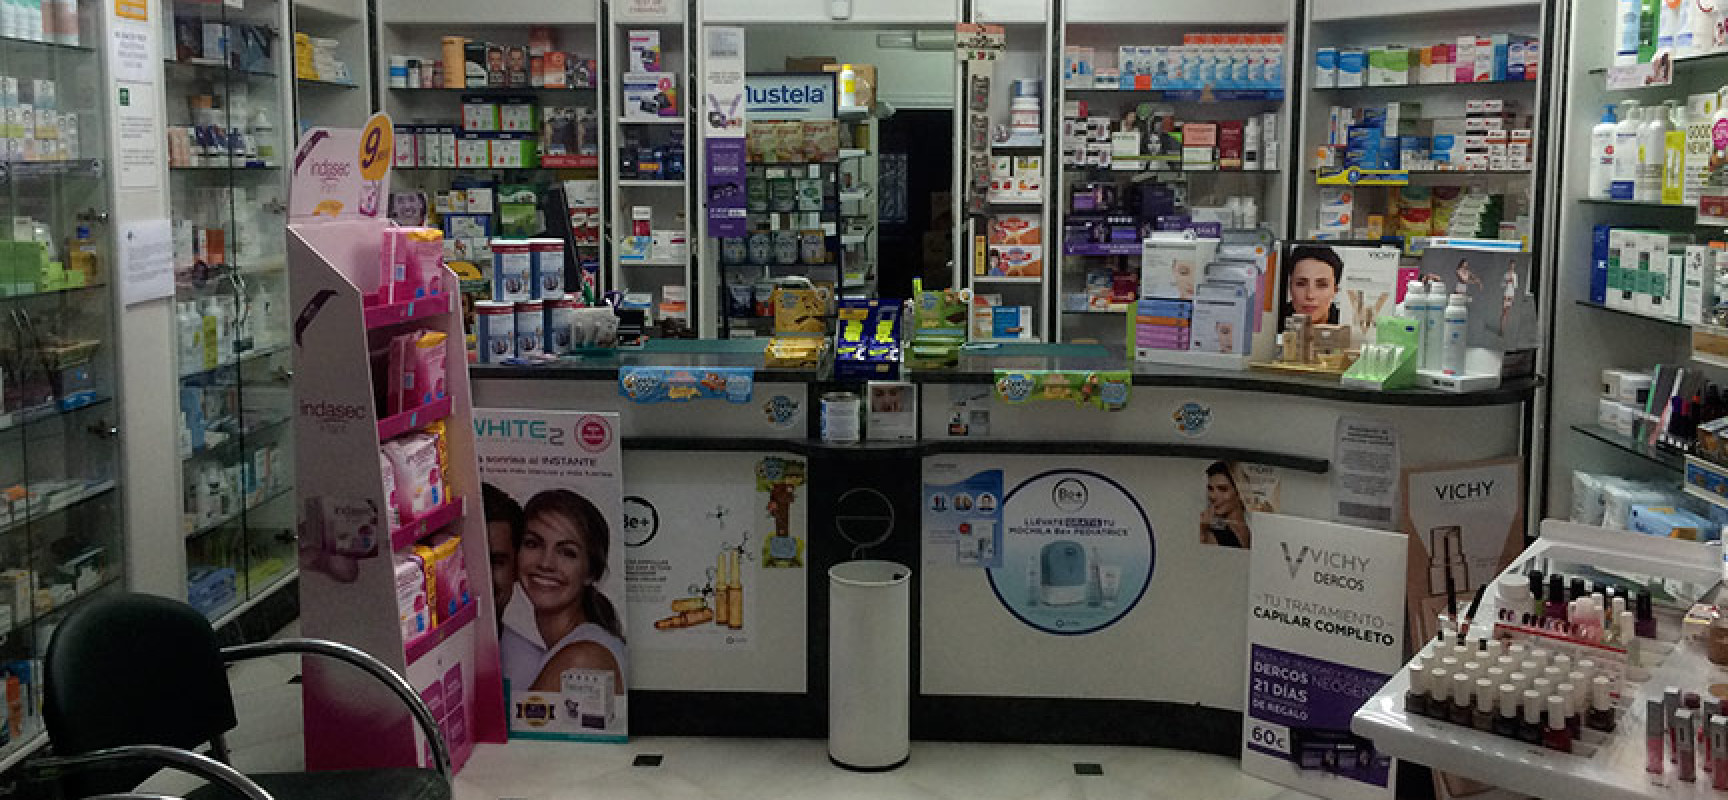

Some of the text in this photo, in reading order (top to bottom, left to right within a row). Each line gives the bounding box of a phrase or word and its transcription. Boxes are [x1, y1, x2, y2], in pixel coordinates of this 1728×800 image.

[362, 127, 382, 169] 9
[310, 159, 351, 177] indasec
[300, 399, 367, 420] indasec
[1058, 486, 1084, 501] Be+
[1435, 480, 1495, 500] VICHY
[1310, 548, 1371, 573] VICHY
[1314, 571, 1365, 592] DERCOS
[1284, 597, 1385, 629] TRATAMIENTO
[1253, 605, 1395, 647] CAPILAR COMPLETO
[1254, 661, 1309, 686] DERCOS
[1253, 677, 1270, 694] 21
